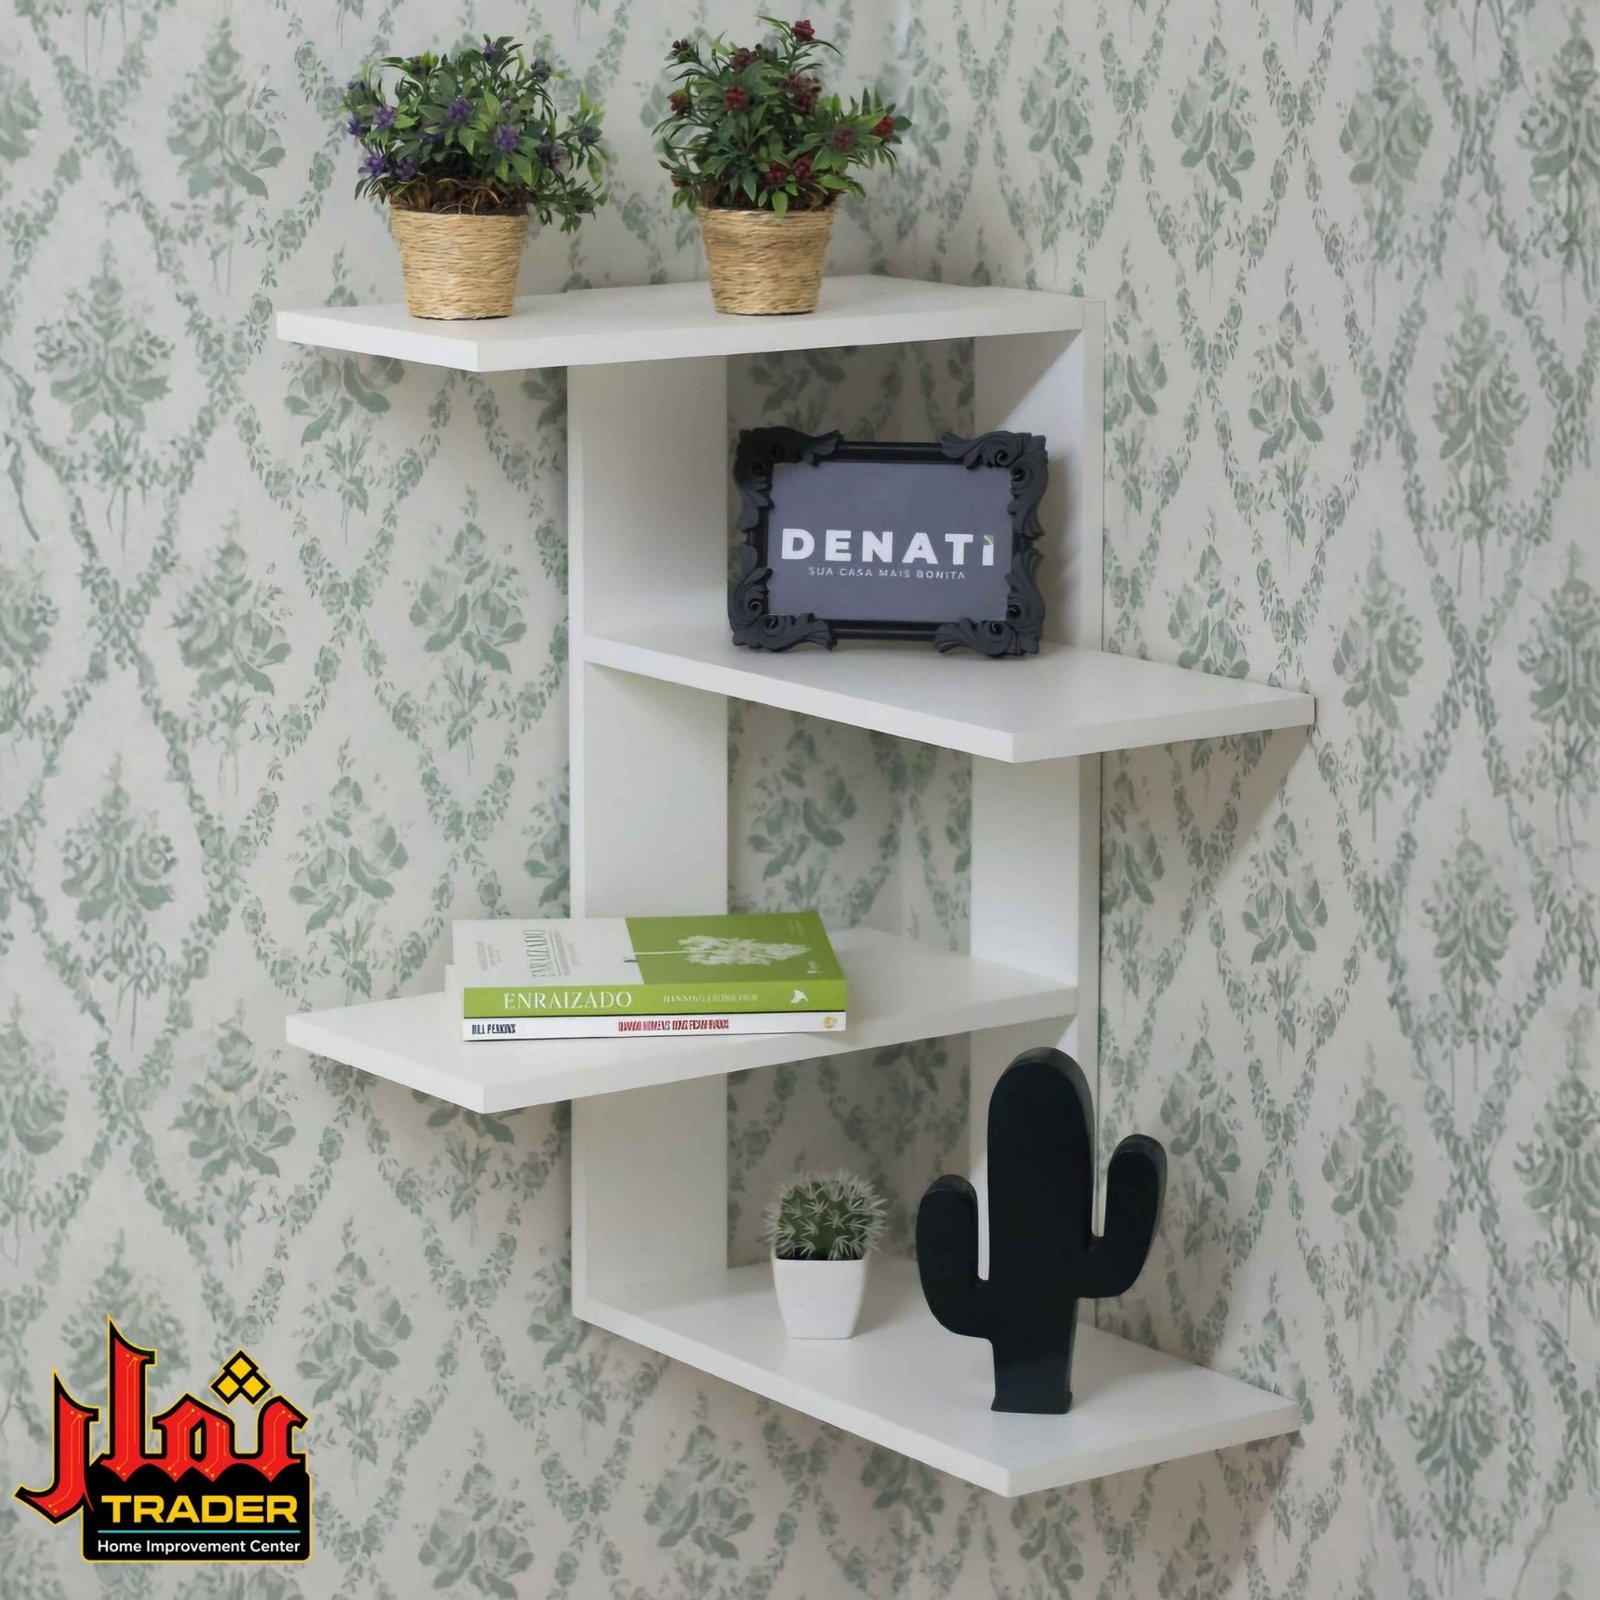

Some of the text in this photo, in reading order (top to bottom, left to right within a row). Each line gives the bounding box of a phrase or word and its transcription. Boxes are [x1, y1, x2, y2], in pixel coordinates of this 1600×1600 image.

[808, 567, 966, 580] SUA CASA MAIS BONITA
[504, 991, 632, 1010] ENRAIZADO
